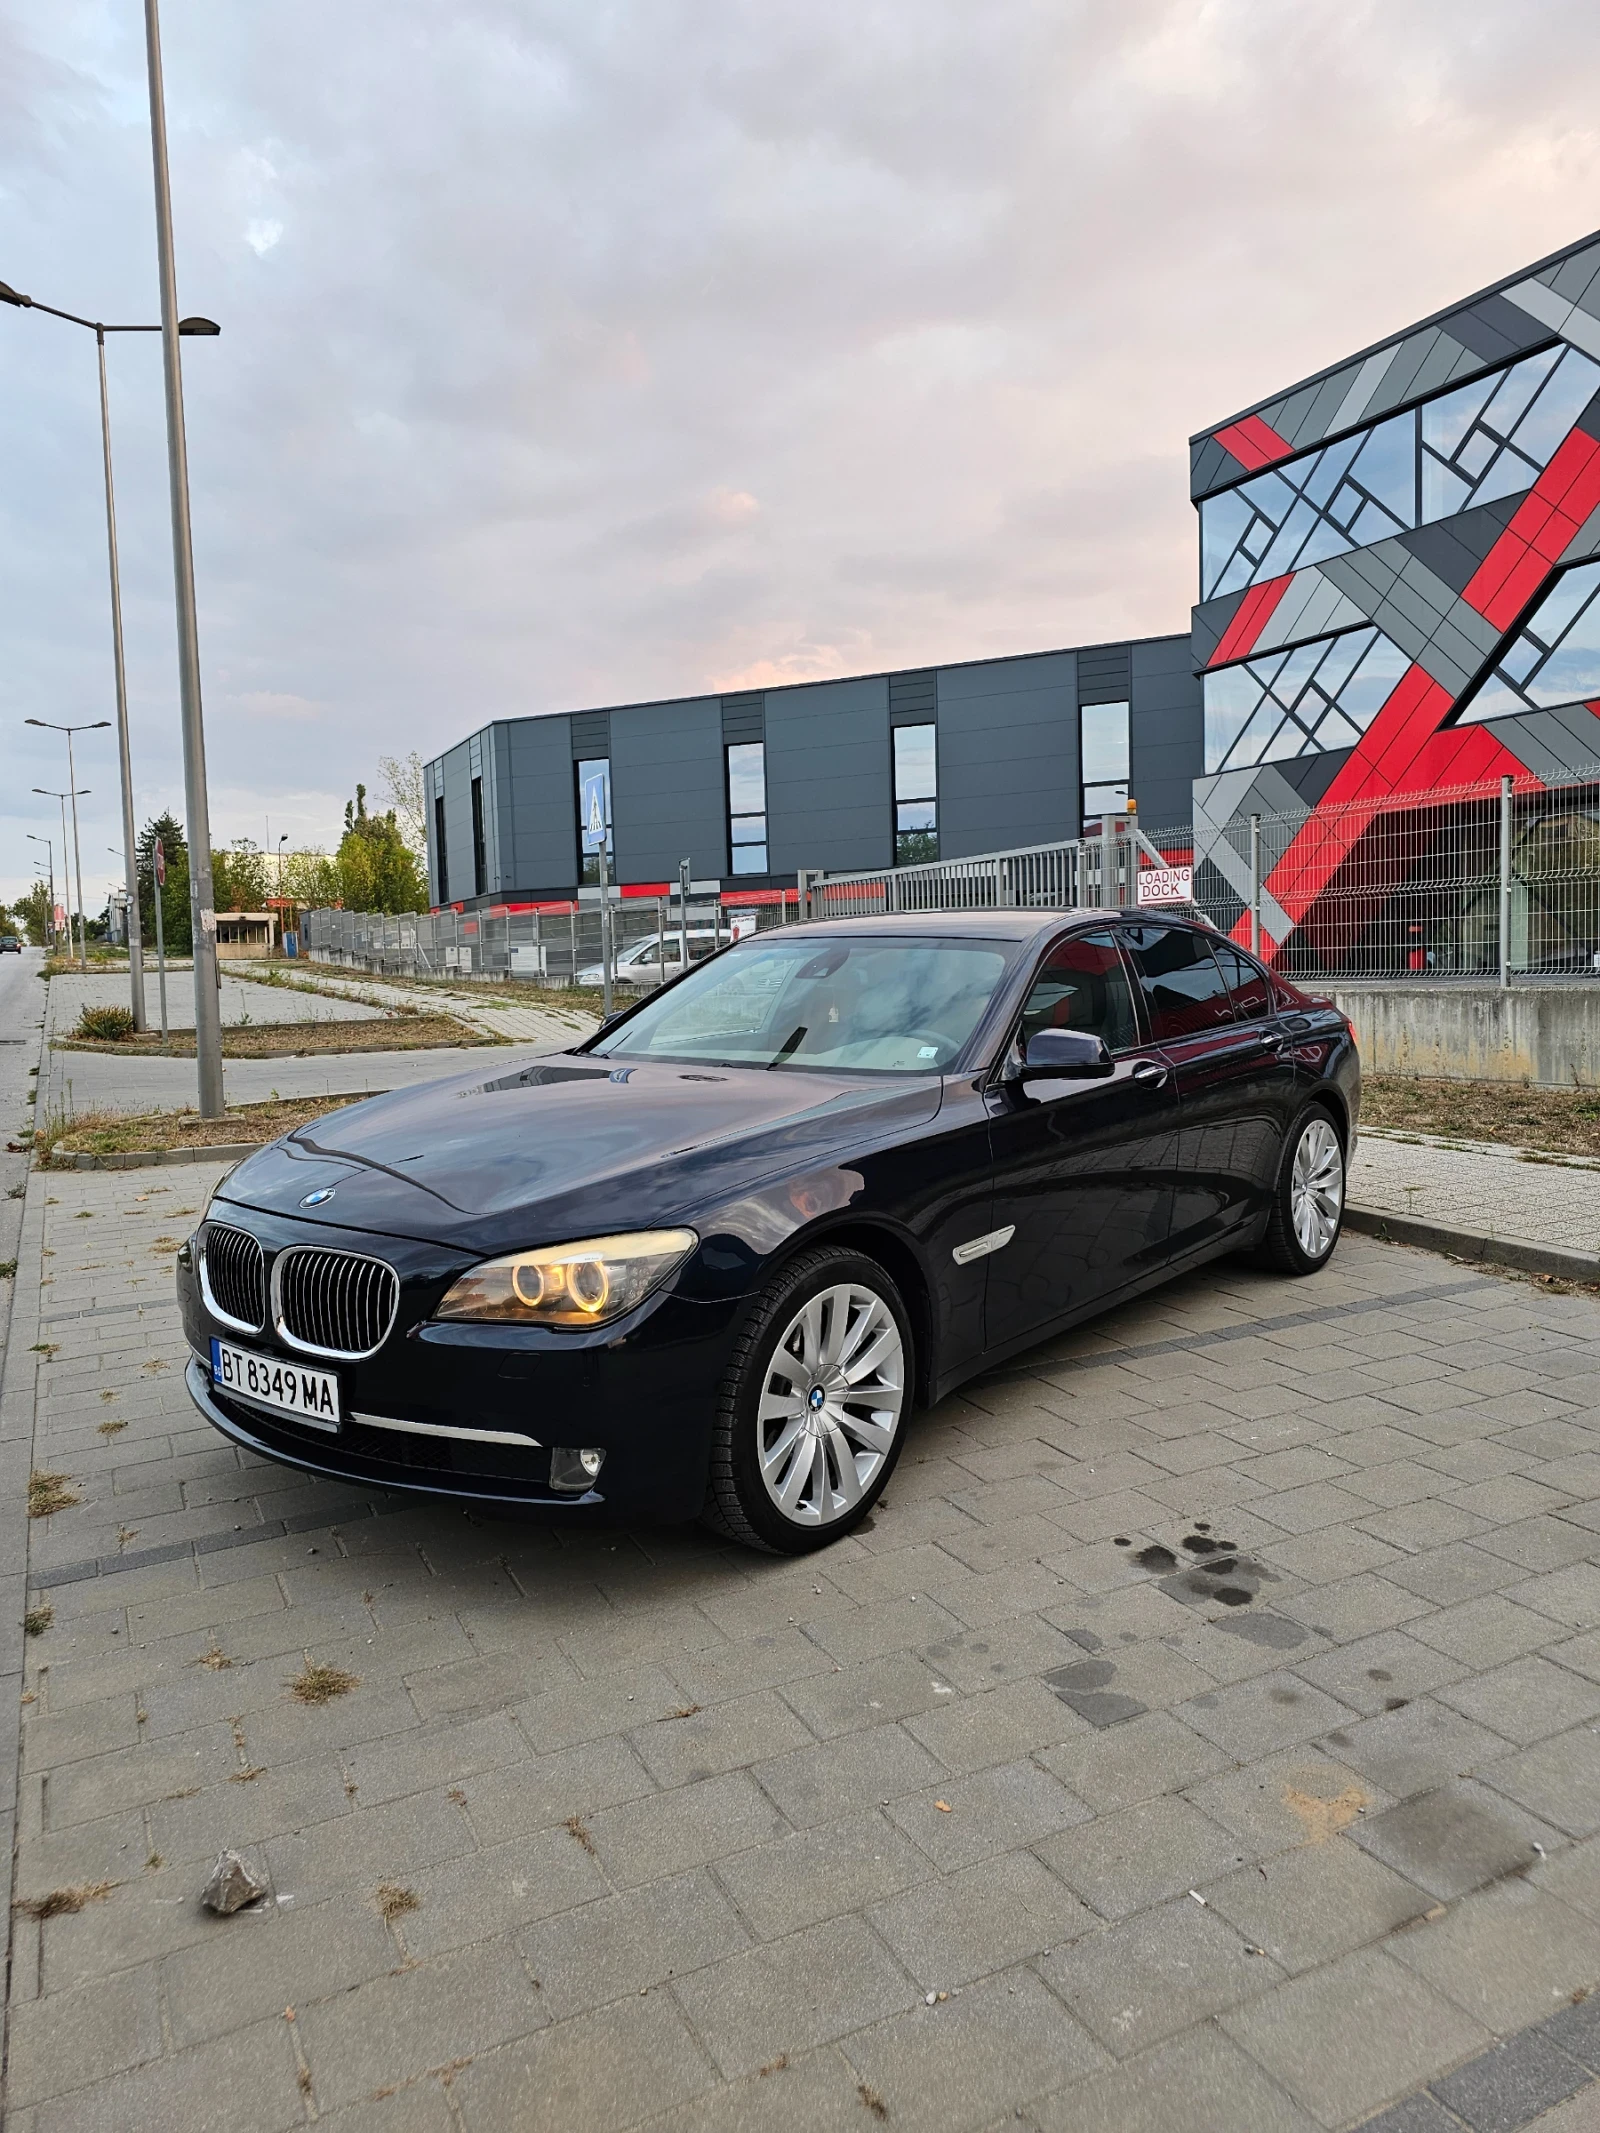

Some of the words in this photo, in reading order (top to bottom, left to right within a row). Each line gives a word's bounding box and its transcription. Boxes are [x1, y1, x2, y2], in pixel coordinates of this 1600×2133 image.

[1139, 869, 1190, 885] LOADING
[1143, 883, 1180, 897] DOCK
[213, 1365, 222, 1376] BG
[221, 1348, 242, 1387] BT
[247, 1359, 297, 1405] 8349
[301, 1373, 335, 1416] MA
